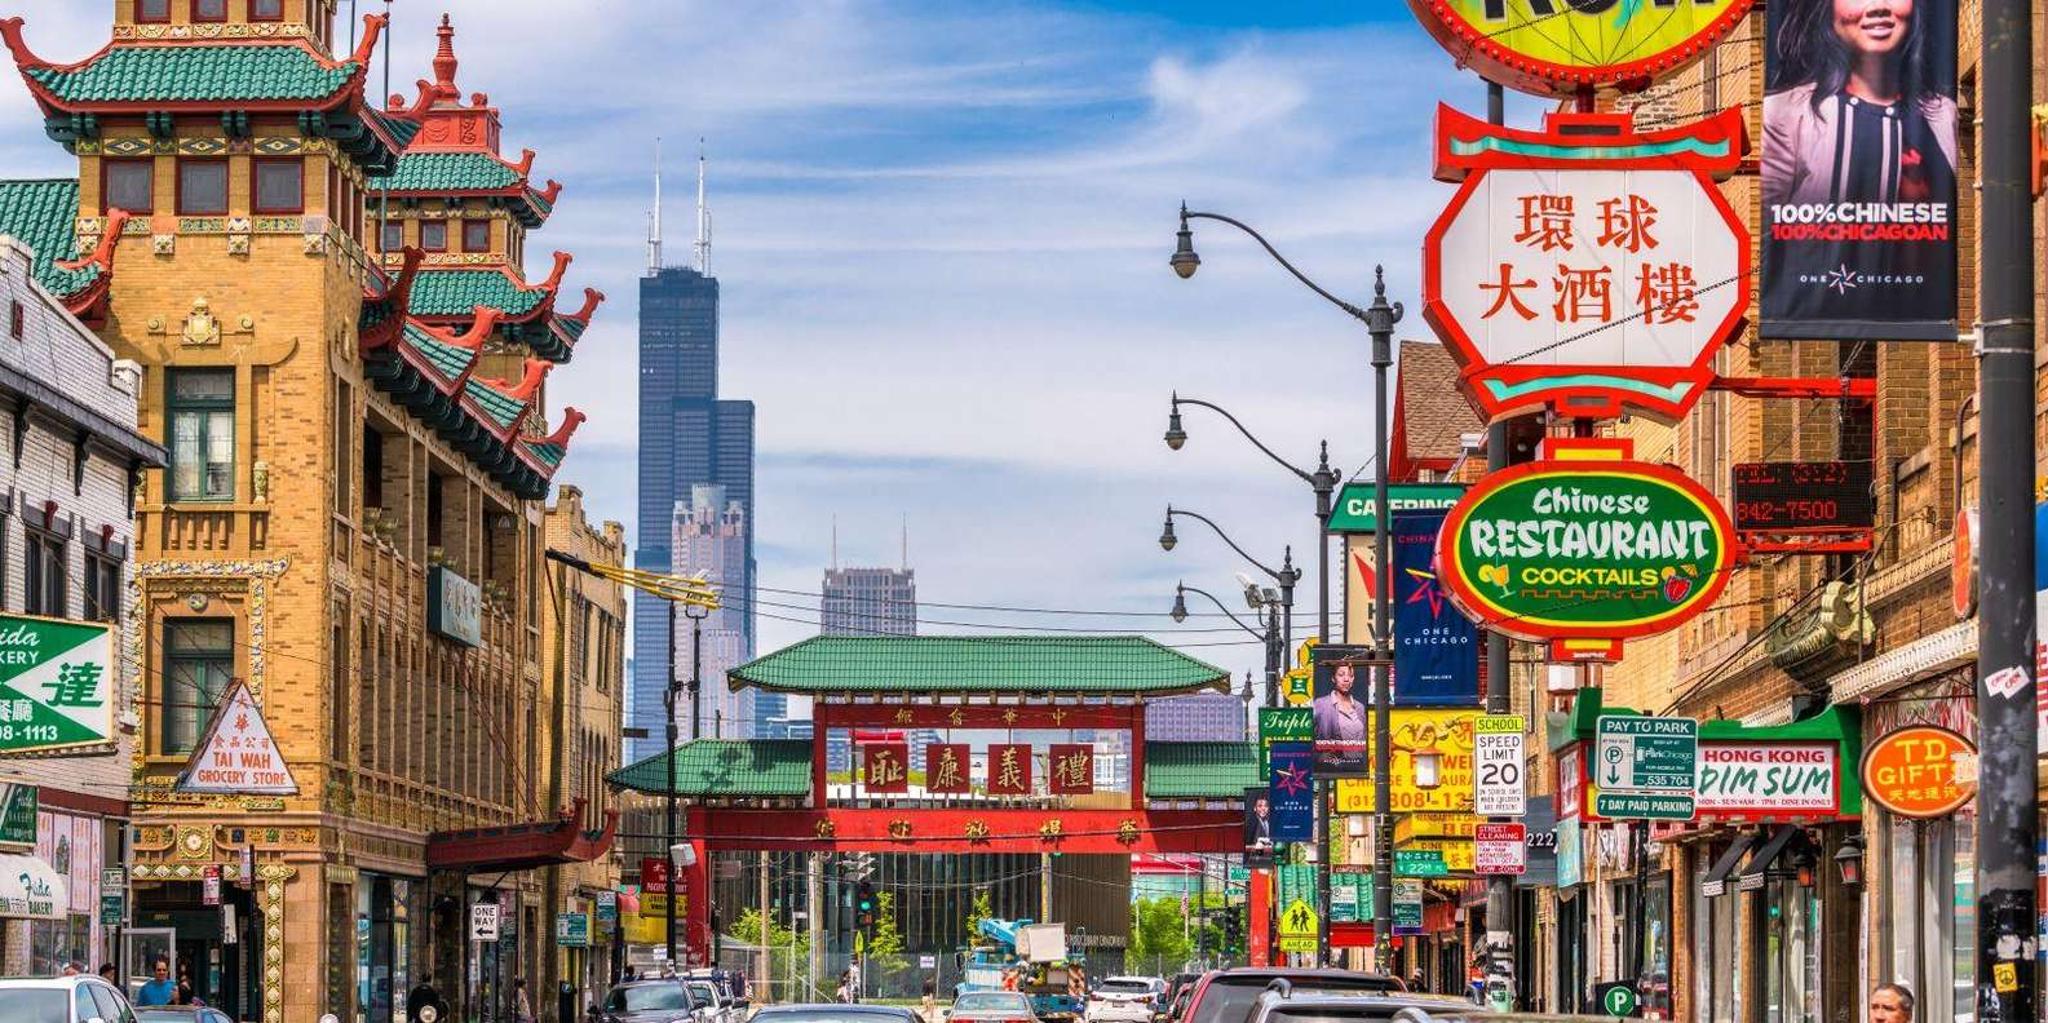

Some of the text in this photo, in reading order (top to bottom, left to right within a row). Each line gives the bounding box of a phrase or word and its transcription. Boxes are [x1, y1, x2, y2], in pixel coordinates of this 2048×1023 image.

[1771, 202, 1947, 223] 100%CHINESE
[1514, 194, 1659, 253] 環球
[1771, 224, 1947, 240] 100%CHICAGOAN
[1800, 275, 1924, 283] ONE CHICAGO
[1479, 263, 1699, 324] 大酒樓
[1533, 487, 1649, 514] Chinese
[1736, 500, 1836, 520] 842-7500
[1469, 519, 1710, 560] RESTAURANT
[1521, 567, 1659, 586] COCKTAILS
[1422, 627, 1449, 636] ONE
[1404, 636, 1468, 645] CHICAGO
[41, 662, 104, 707] 達
[1264, 711, 1313, 735] Triple
[1478, 719, 1521, 731] SCHOOL
[1606, 721, 1690, 733] PAY TO PARK
[0, 725, 58, 741] 8-1113
[1479, 735, 1521, 748] SPEED
[1483, 749, 1516, 760] LIMIT
[1704, 750, 1825, 763] HONG KONG
[1894, 739, 1947, 763] TD
[213, 752, 271, 769] TAI WAH
[198, 769, 287, 786] GROCERY STORE
[1481, 763, 1519, 785] 20
[1698, 764, 1832, 797] DIM SUM
[1877, 763, 1956, 785] GIFT
[1600, 800, 1692, 812] 7 DAY PAID PARKING
[475, 907, 495, 917] ONE
[474, 917, 495, 926] WAY
